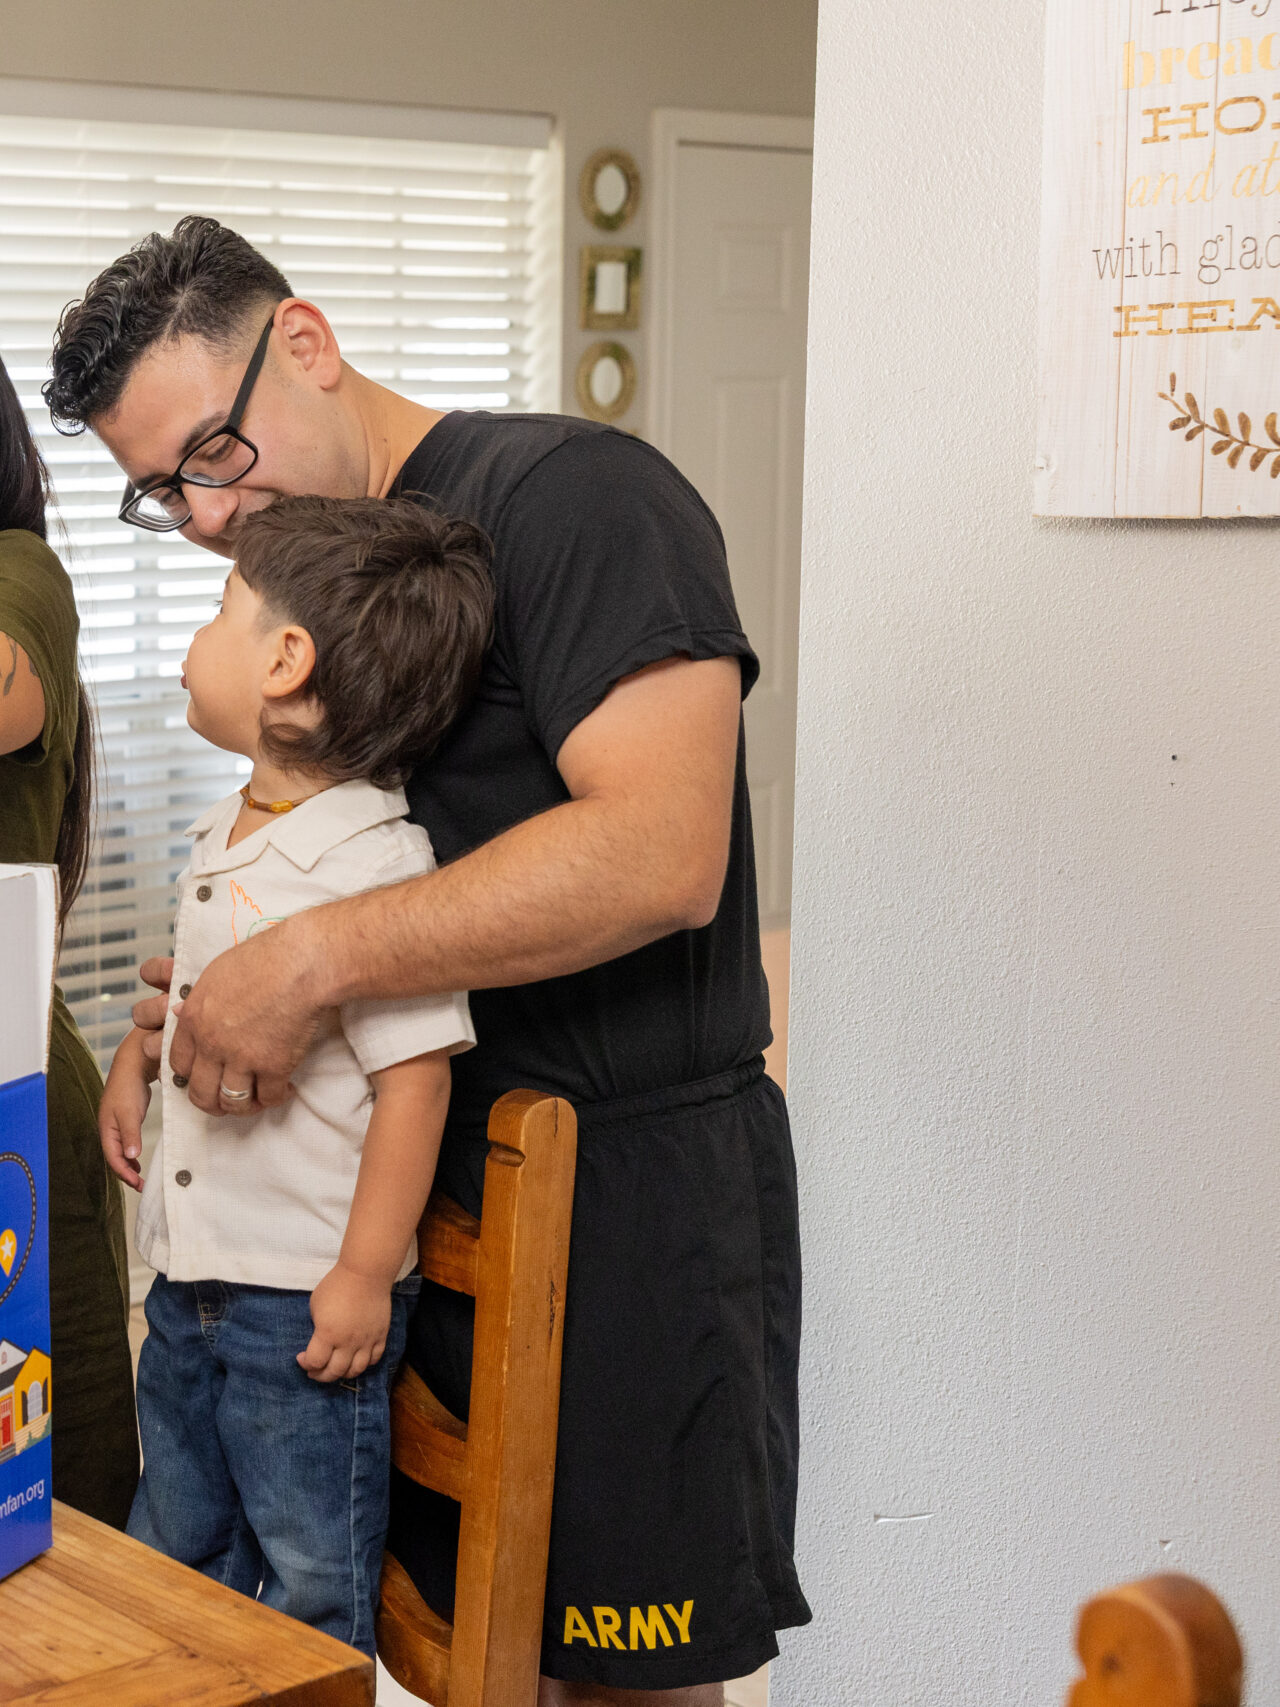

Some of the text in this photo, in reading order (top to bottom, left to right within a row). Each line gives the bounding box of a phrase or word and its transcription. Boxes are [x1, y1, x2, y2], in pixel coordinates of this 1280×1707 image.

[1141, 92, 1280, 144] HO
[1127, 141, 1280, 208] and at
[1092, 230, 1181, 279] with
[563, 1600, 694, 1650] ARMY
